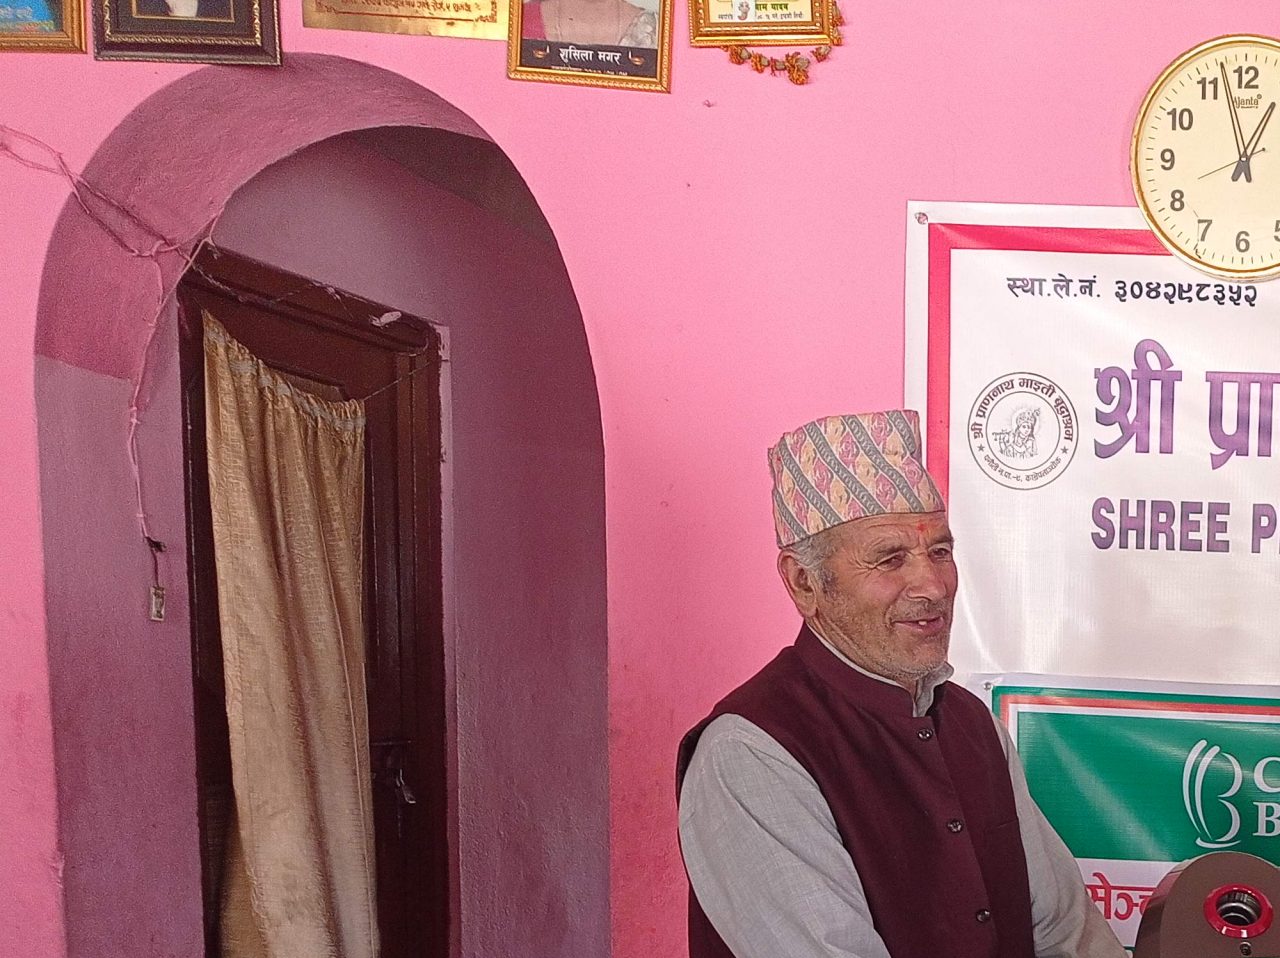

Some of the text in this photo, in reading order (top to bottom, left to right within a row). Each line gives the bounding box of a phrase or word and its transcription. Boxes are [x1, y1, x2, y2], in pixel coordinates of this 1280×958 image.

[1197, 77, 1219, 100] 11
[1233, 66, 1259, 89] 12
[1167, 108, 1194, 131] 10
[1160, 149, 1175, 171] 9
[1170, 189, 1185, 212] 8
[1197, 219, 1213, 242] 7
[1235, 231, 1250, 252] 6
[1115, 280, 1258, 307] ३०४२९८३५२
[970, 421, 984, 439] श्री
[1018, 377, 1056, 398] माइती
[1094, 338, 1183, 459] श्री
[1091, 497, 1230, 552] SHREE
